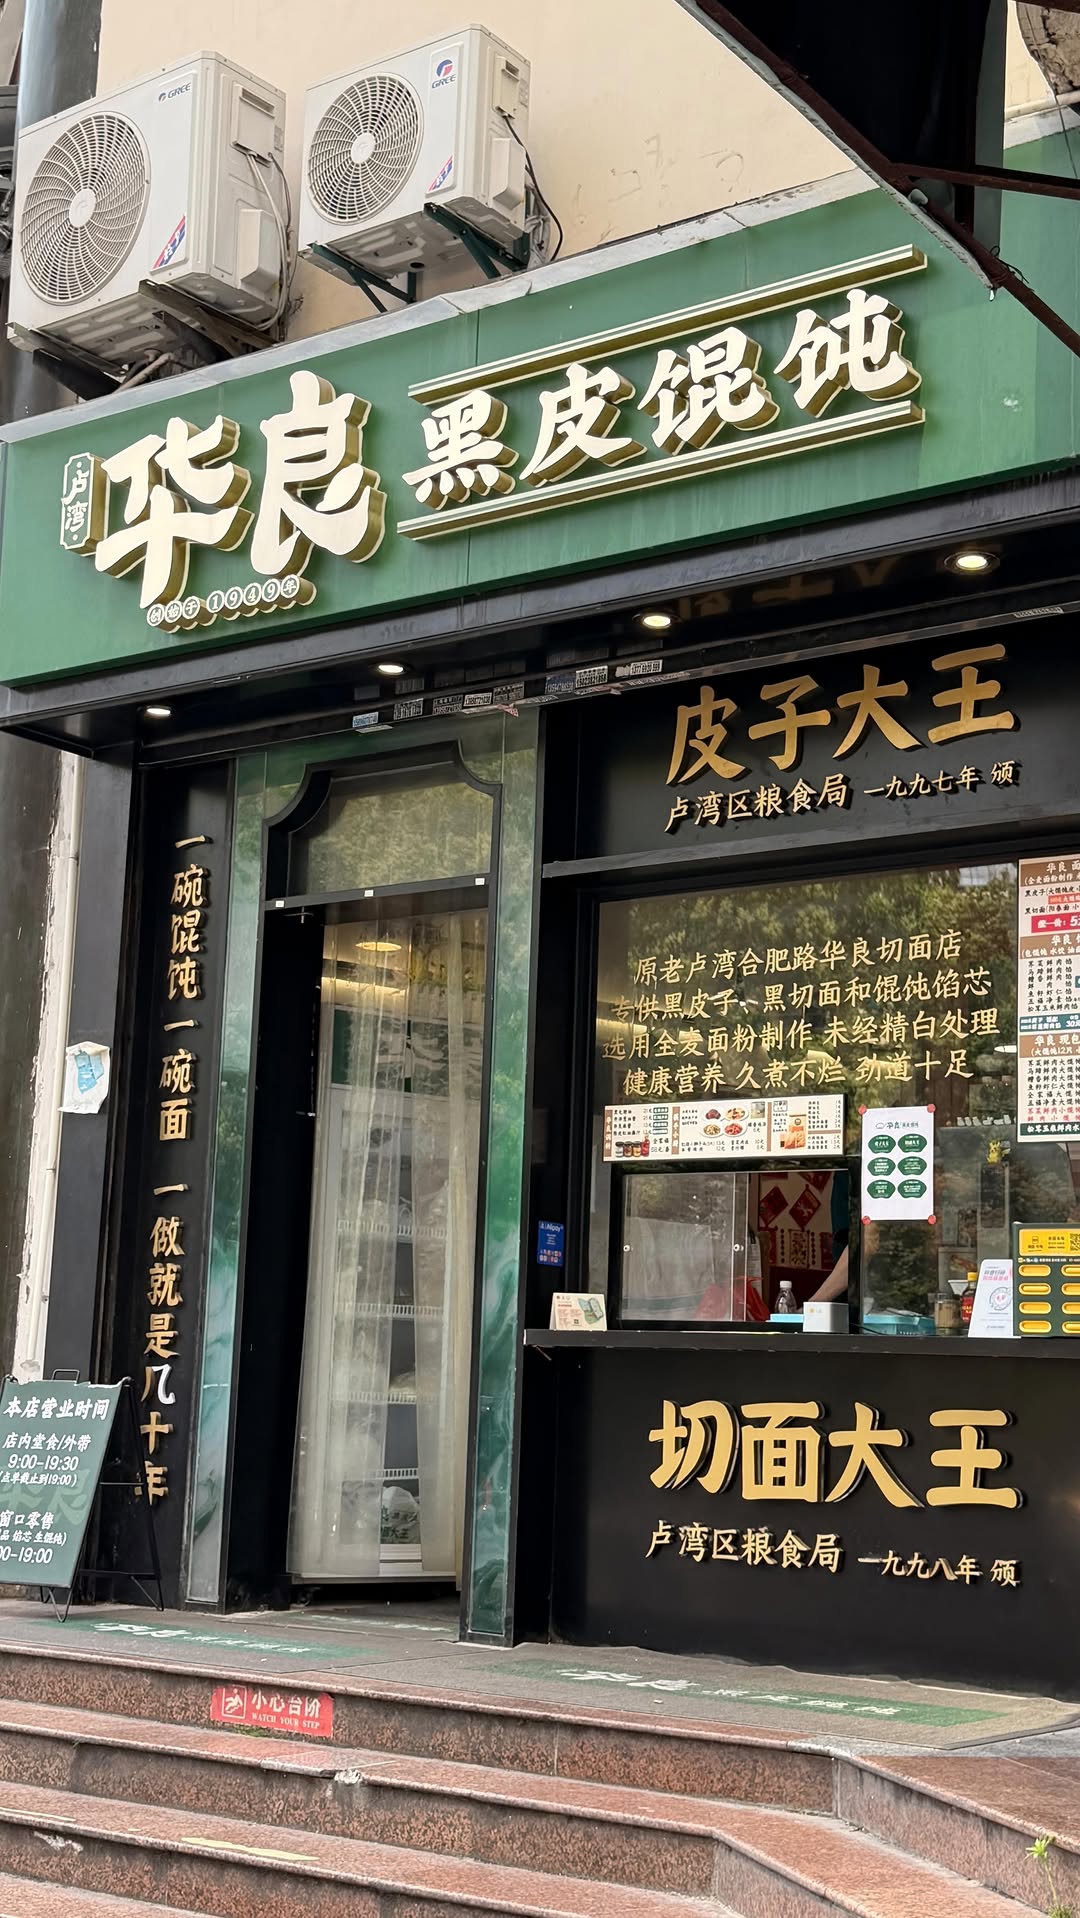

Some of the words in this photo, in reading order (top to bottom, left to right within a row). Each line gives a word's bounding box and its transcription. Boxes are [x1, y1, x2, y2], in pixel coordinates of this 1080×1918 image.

[167, 83, 191, 98] GREE
[432, 74, 456, 88] GREE
[401, 288, 910, 502] 黑皮馄饨
[64, 469, 90, 533] 卢湾
[95, 369, 373, 609] 华良
[147, 595, 201, 627] 创始于
[207, 573, 301, 613] 1949年
[665, 643, 1016, 786] 皮子大王
[664, 772, 849, 833] 卢湾区粮食局
[862, 764, 980, 800] 一九九七年
[990, 760, 1017, 787] 颁
[634, 928, 963, 987] 原老卢湾合肥路华良切面店
[158, 834, 209, 1142] 一碗馄饨一碗面
[611, 966, 994, 1023] 专供黑皮子、黑切面和馄饨馅芯
[602, 1017, 815, 1061] 选用全麦面粉制作
[822, 1006, 1001, 1047] 未经精白处理
[623, 1061, 727, 1097] 健康营养
[730, 1054, 847, 1092] 久煮不烂
[854, 1047, 975, 1086] 劲道十足
[3, 1395, 110, 1422] 本店营业时间
[2, 1431, 92, 1453] 店内堂食/外带
[8, 1453, 80, 1472] 9:00-19:30
[648, 1399, 1020, 1509] 切面大王
[0, 1509, 55, 1530] 窗口零售
[645, 1519, 843, 1574] 卢湾区粮食局
[857, 1549, 983, 1586] 一九九八年
[990, 1558, 1019, 1588] 颁
[251, 1689, 322, 1719] 小心台阶
[251, 1712, 277, 1724] WATCH
[280, 1716, 299, 1728] YOUR
[302, 1720, 321, 1730] STEP
